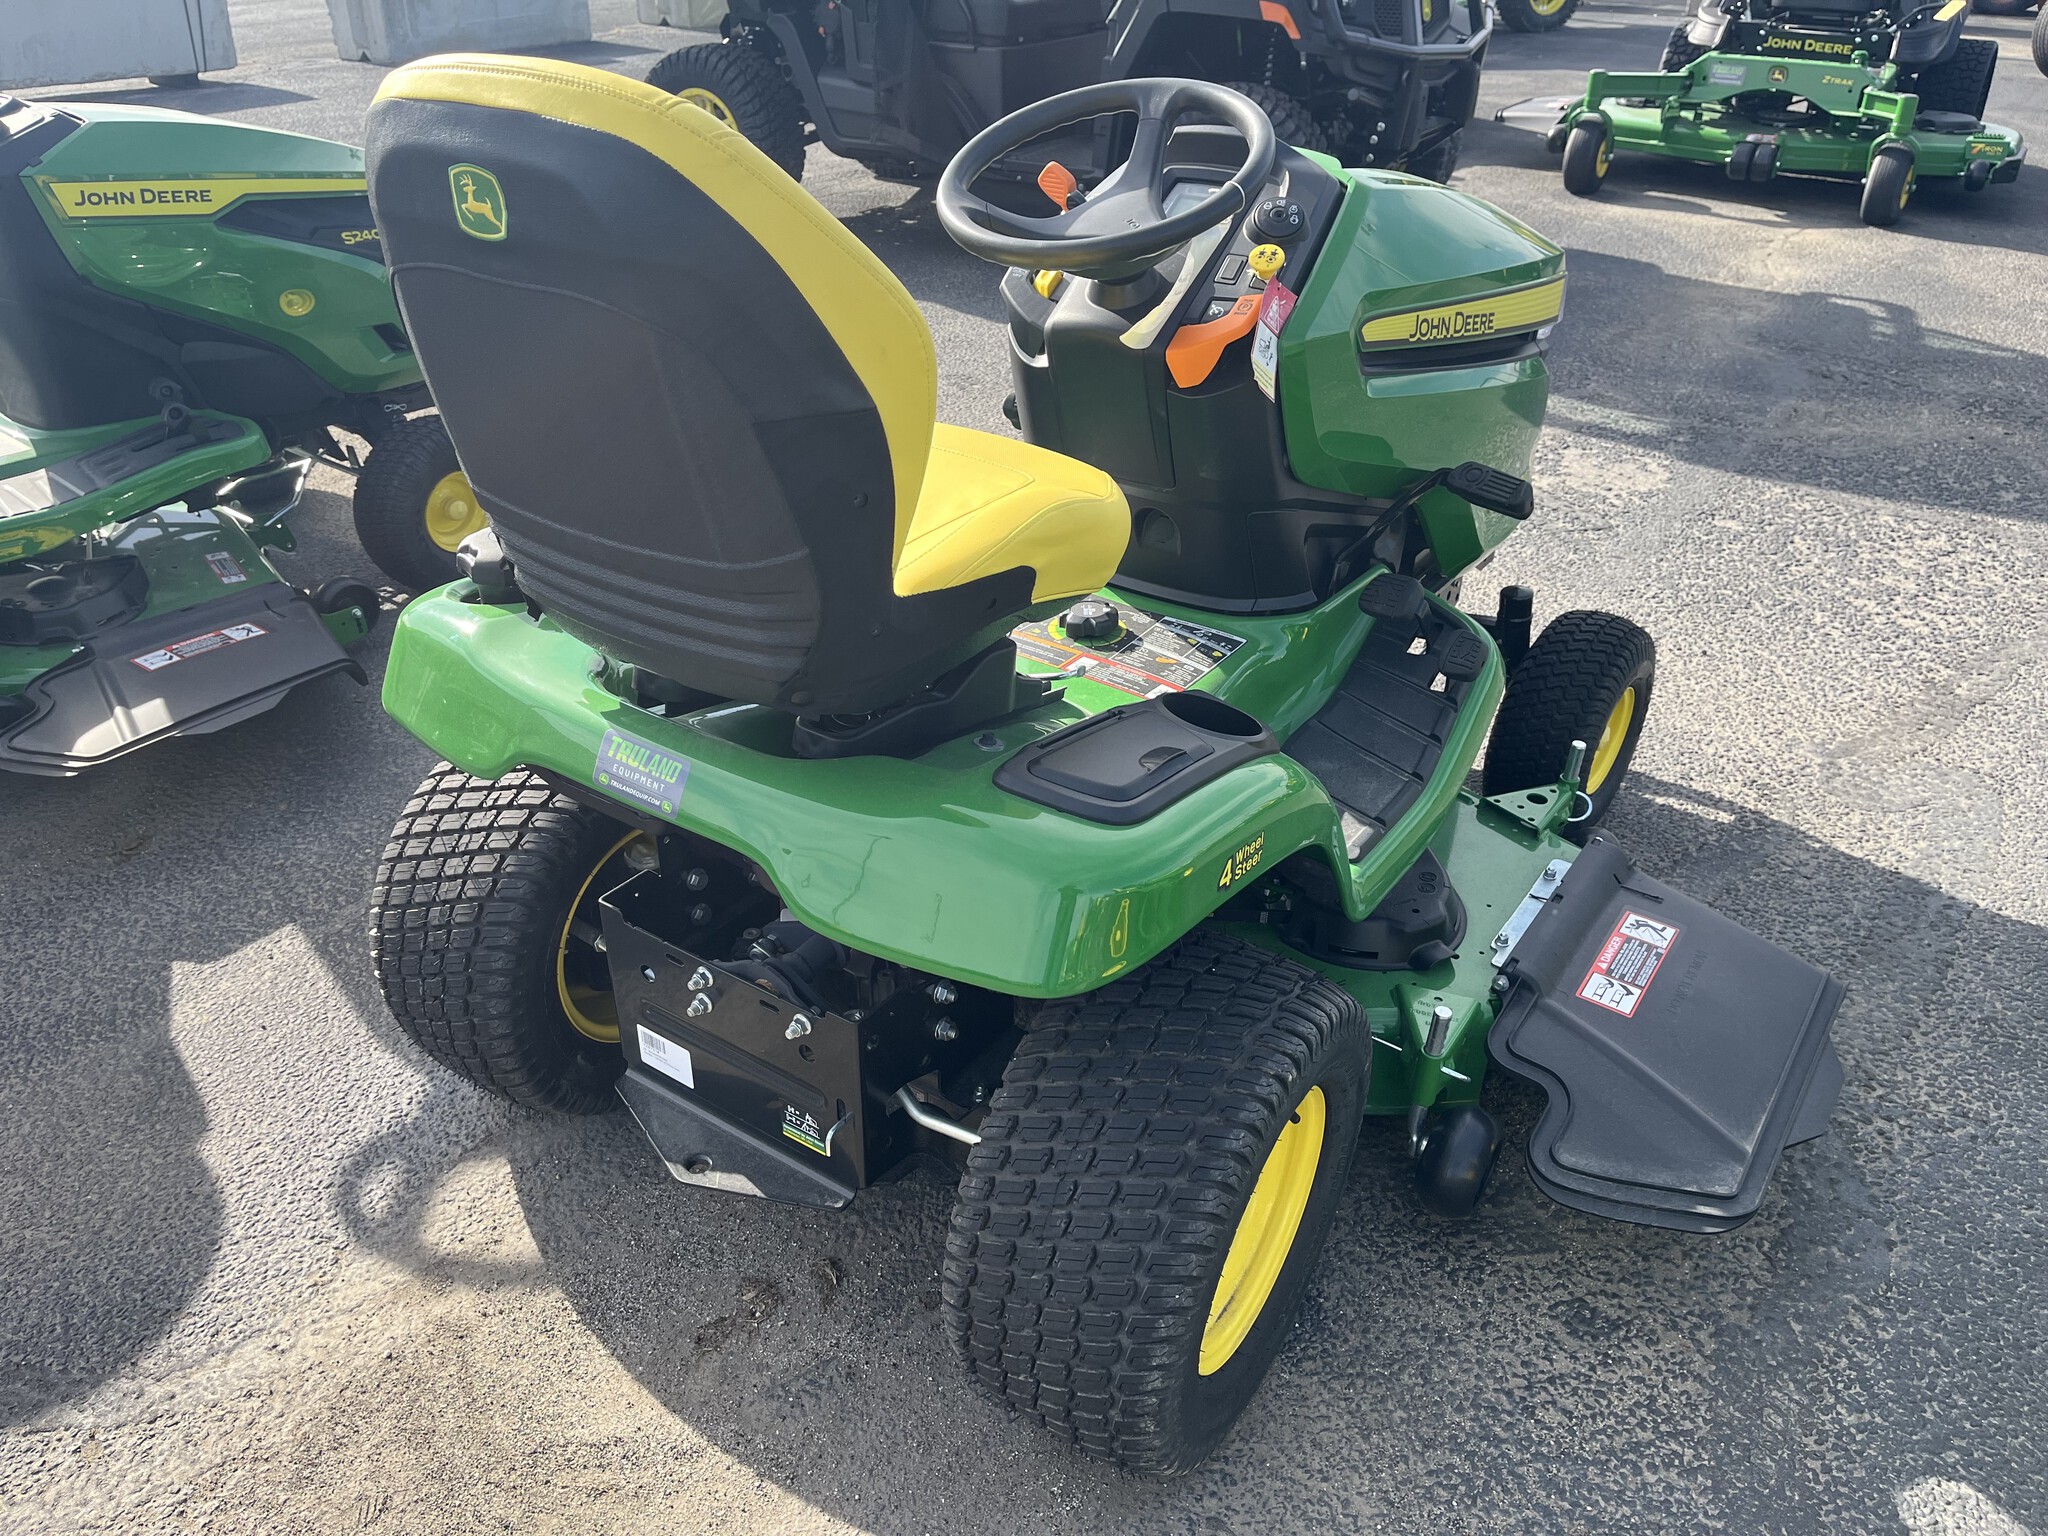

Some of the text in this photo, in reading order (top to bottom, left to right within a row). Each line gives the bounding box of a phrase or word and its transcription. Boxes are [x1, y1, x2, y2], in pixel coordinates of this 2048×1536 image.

[1762, 36, 1853, 55] JOHN DEERE
[74, 188, 213, 206] JOHN DEERE
[1410, 312, 1495, 340] JOHN DEERE
[607, 735, 683, 784] TRULAND
[612, 763, 666, 792] EQUIPMENT
[610, 780, 661, 806] TRULANDEQUIP.COM
[1235, 831, 1265, 865] Wheel
[1219, 858, 1233, 887] 4
[1234, 850, 1263, 880] Steer
[1599, 936, 1623, 962] DANGER
